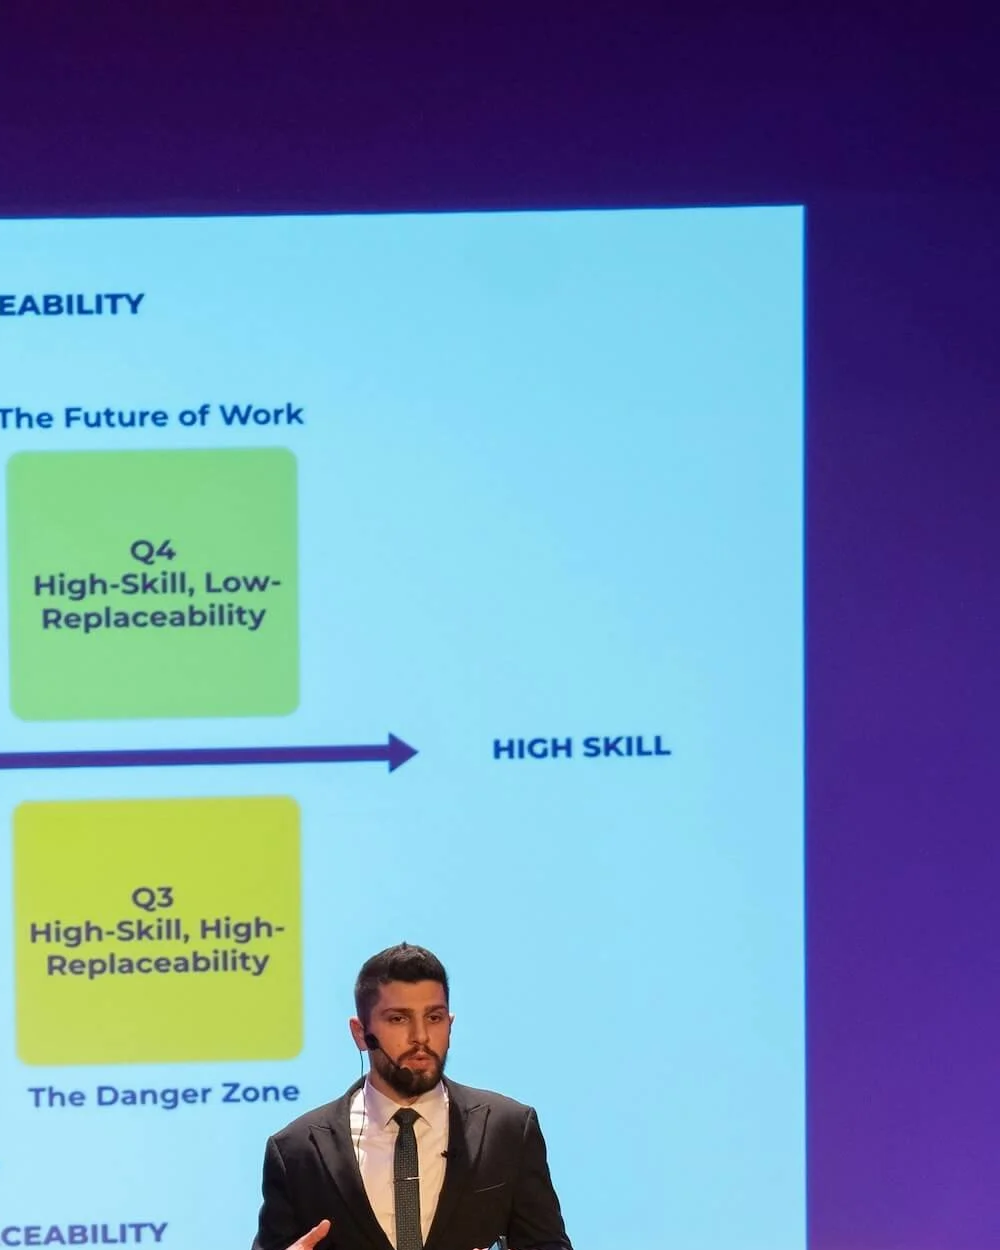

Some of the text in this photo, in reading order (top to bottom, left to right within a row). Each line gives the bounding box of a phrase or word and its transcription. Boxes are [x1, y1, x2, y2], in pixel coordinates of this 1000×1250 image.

[64, 407, 169, 429] Future
[178, 404, 211, 427] of
[218, 402, 304, 426] Work
[130, 539, 177, 566] Q4
[34, 571, 281, 602] High-Skill, Low-
[42, 602, 267, 634] Replaceability
[493, 735, 672, 760] HIGH SKILL
[131, 886, 174, 913] Q3
[30, 916, 285, 949] High-Skill, High-
[47, 948, 270, 981] Replaceability
[28, 1081, 301, 1111] The Danger Zone
